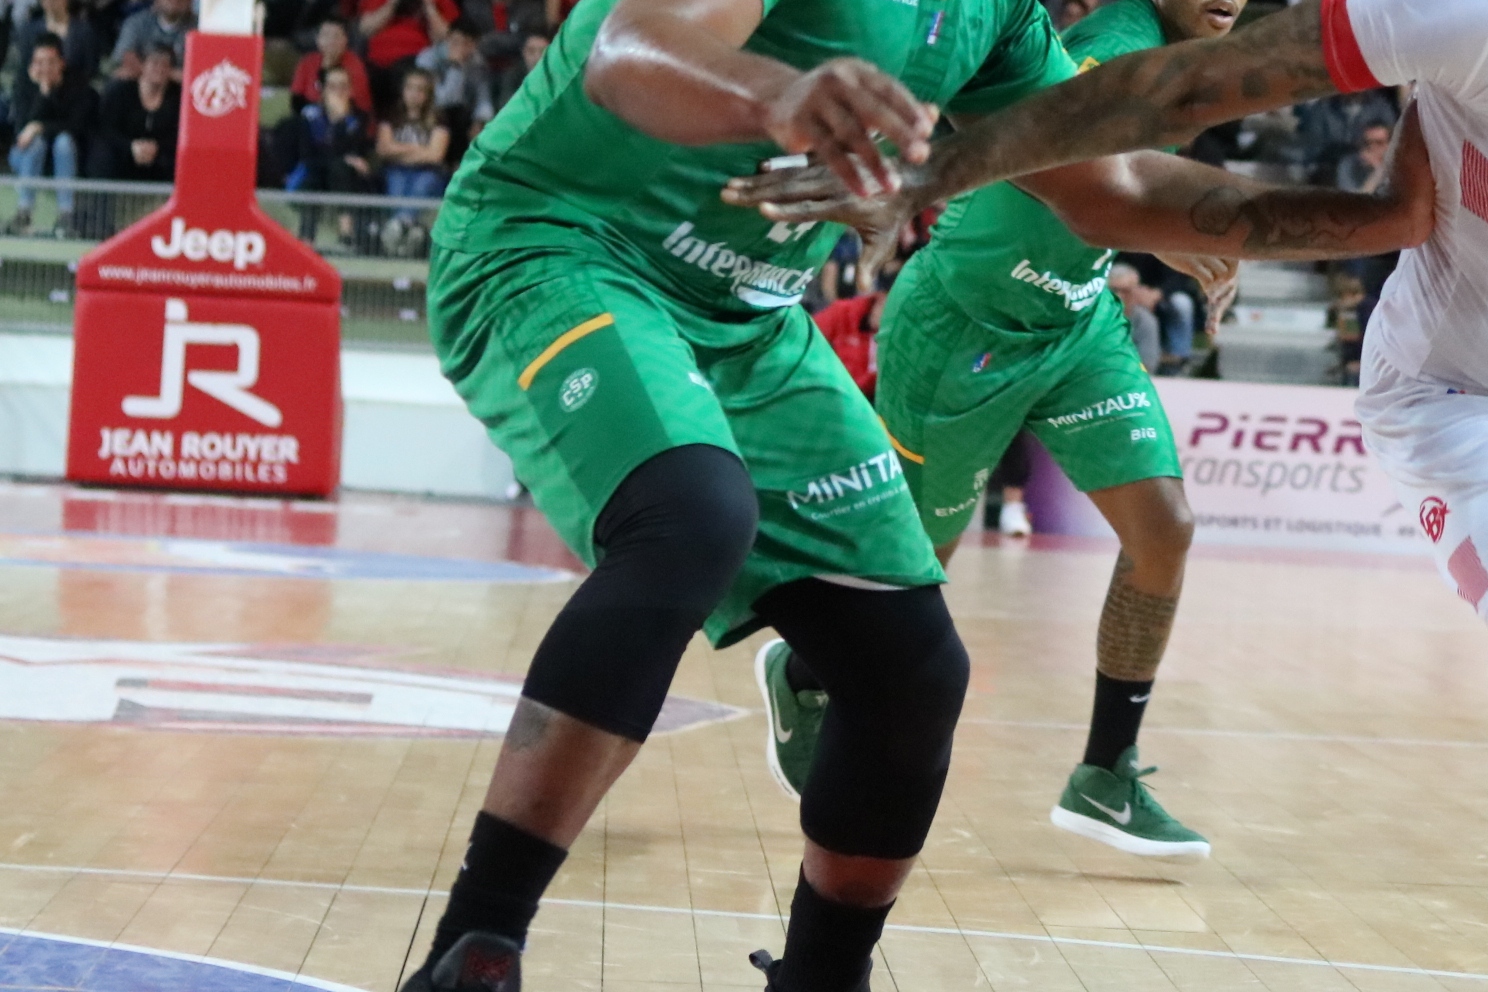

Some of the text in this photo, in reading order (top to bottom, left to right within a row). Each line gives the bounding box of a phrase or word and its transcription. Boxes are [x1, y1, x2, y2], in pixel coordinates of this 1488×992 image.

[151, 217, 267, 271] Jeep
[99, 264, 317, 294] www.jeanrouyerautomobiles.fr
[98, 427, 300, 465] JEAN ROUYER
[110, 455, 288, 485] AUTOMOBILES
[1183, 455, 1366, 497] ransports
